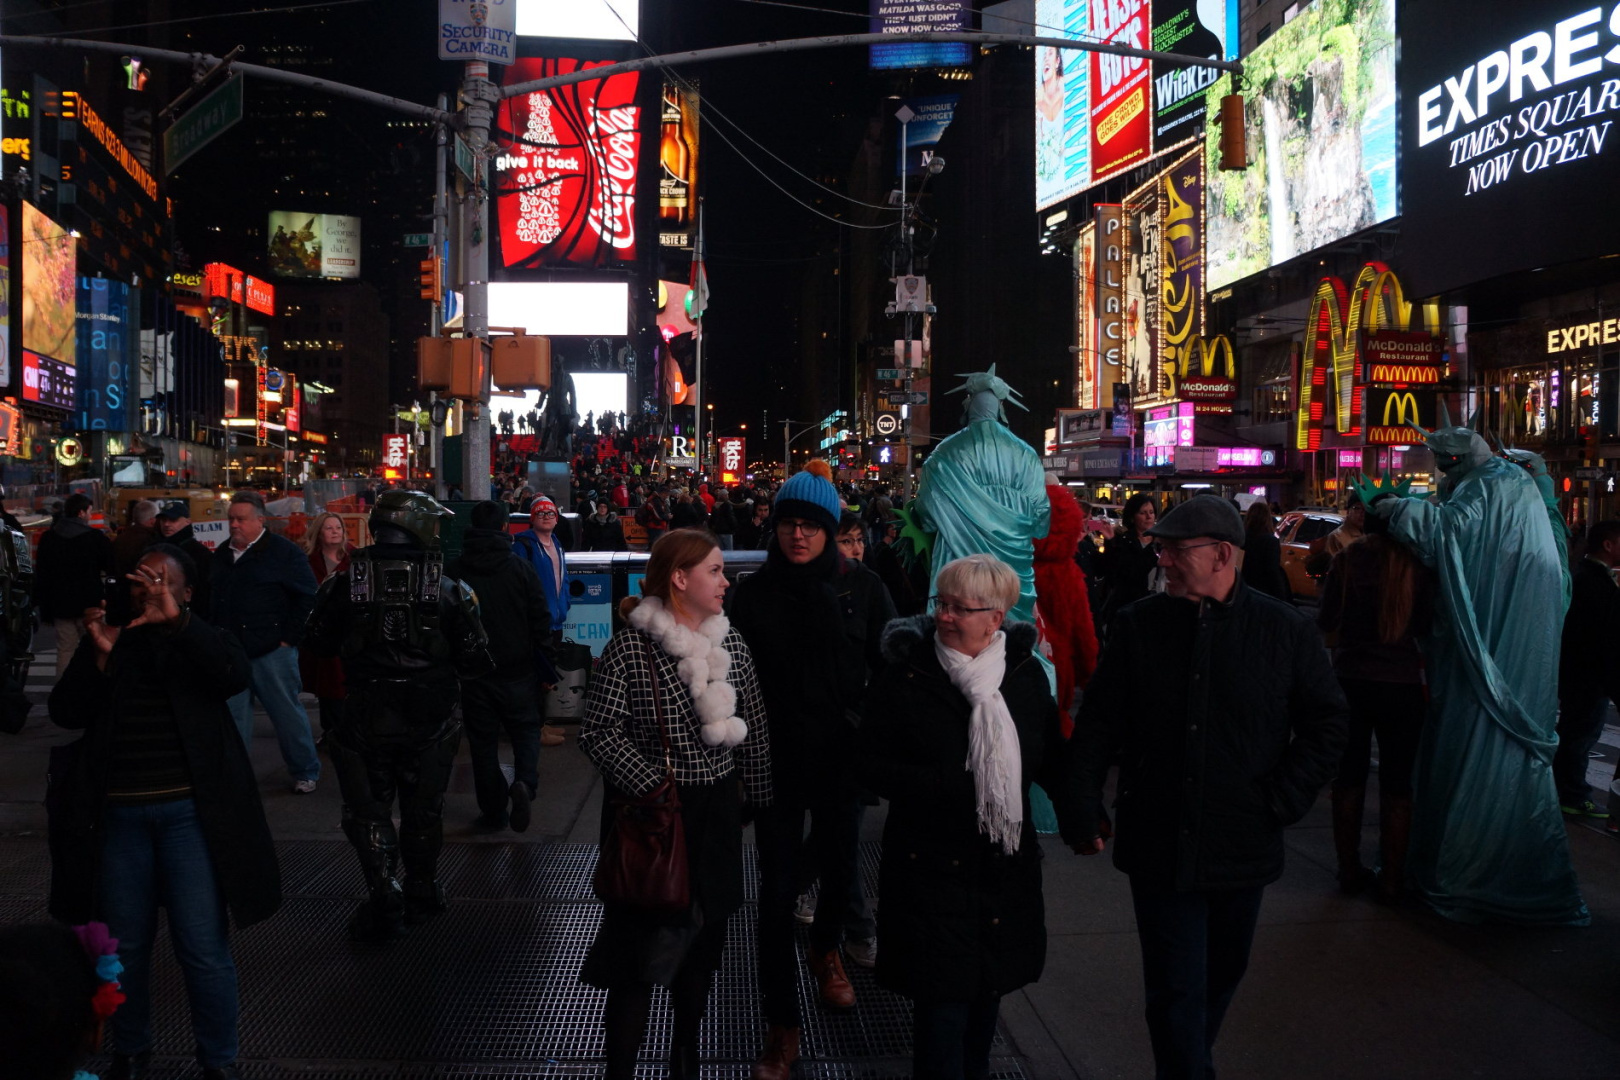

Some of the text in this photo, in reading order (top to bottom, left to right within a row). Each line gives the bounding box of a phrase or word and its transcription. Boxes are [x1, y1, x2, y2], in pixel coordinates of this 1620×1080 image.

[879, 5, 915, 15] MATILDA
[916, 4, 937, 12] WAS
[884, 16, 906, 24] THEY
[928, 13, 957, 21] DIDN'T
[441, 24, 513, 43] SECURITY
[882, 25, 909, 34] KNOW
[910, 24, 932, 33] HOW
[1154, 25, 1177, 45] BIGGEST
[445, 39, 509, 59] CAMERA
[1114, 92, 1140, 117] CROWD
[1100, 120, 1118, 140] GOES
[1449, 114, 1511, 168] TIMES
[496, 155, 579, 171] give it back
[1465, 121, 1613, 196] NOW OPEN
[587, 96, 640, 249] Coca-Cola
[337, 219, 347, 227] By
[326, 227, 357, 238] George,
[680, 235, 688, 245] IS
[331, 245, 342, 253] did
[1105, 218, 1120, 366] PALACE
[75, 311, 120, 324] Morgan Stanley
[1547, 318, 1620, 353] EXPRE
[219, 335, 258, 361] EY'S
[1367, 339, 1441, 354] McDonald's
[1379, 352, 1429, 361] Restaurant
[883, 370, 891, 378] 46
[1180, 383, 1236, 392] McDonald's
[389, 437, 405, 467] tkts
[671, 436, 695, 458] R
[726, 439, 742, 471] tkts
[193, 523, 223, 533] SLAM
[577, 623, 609, 639] CAN
